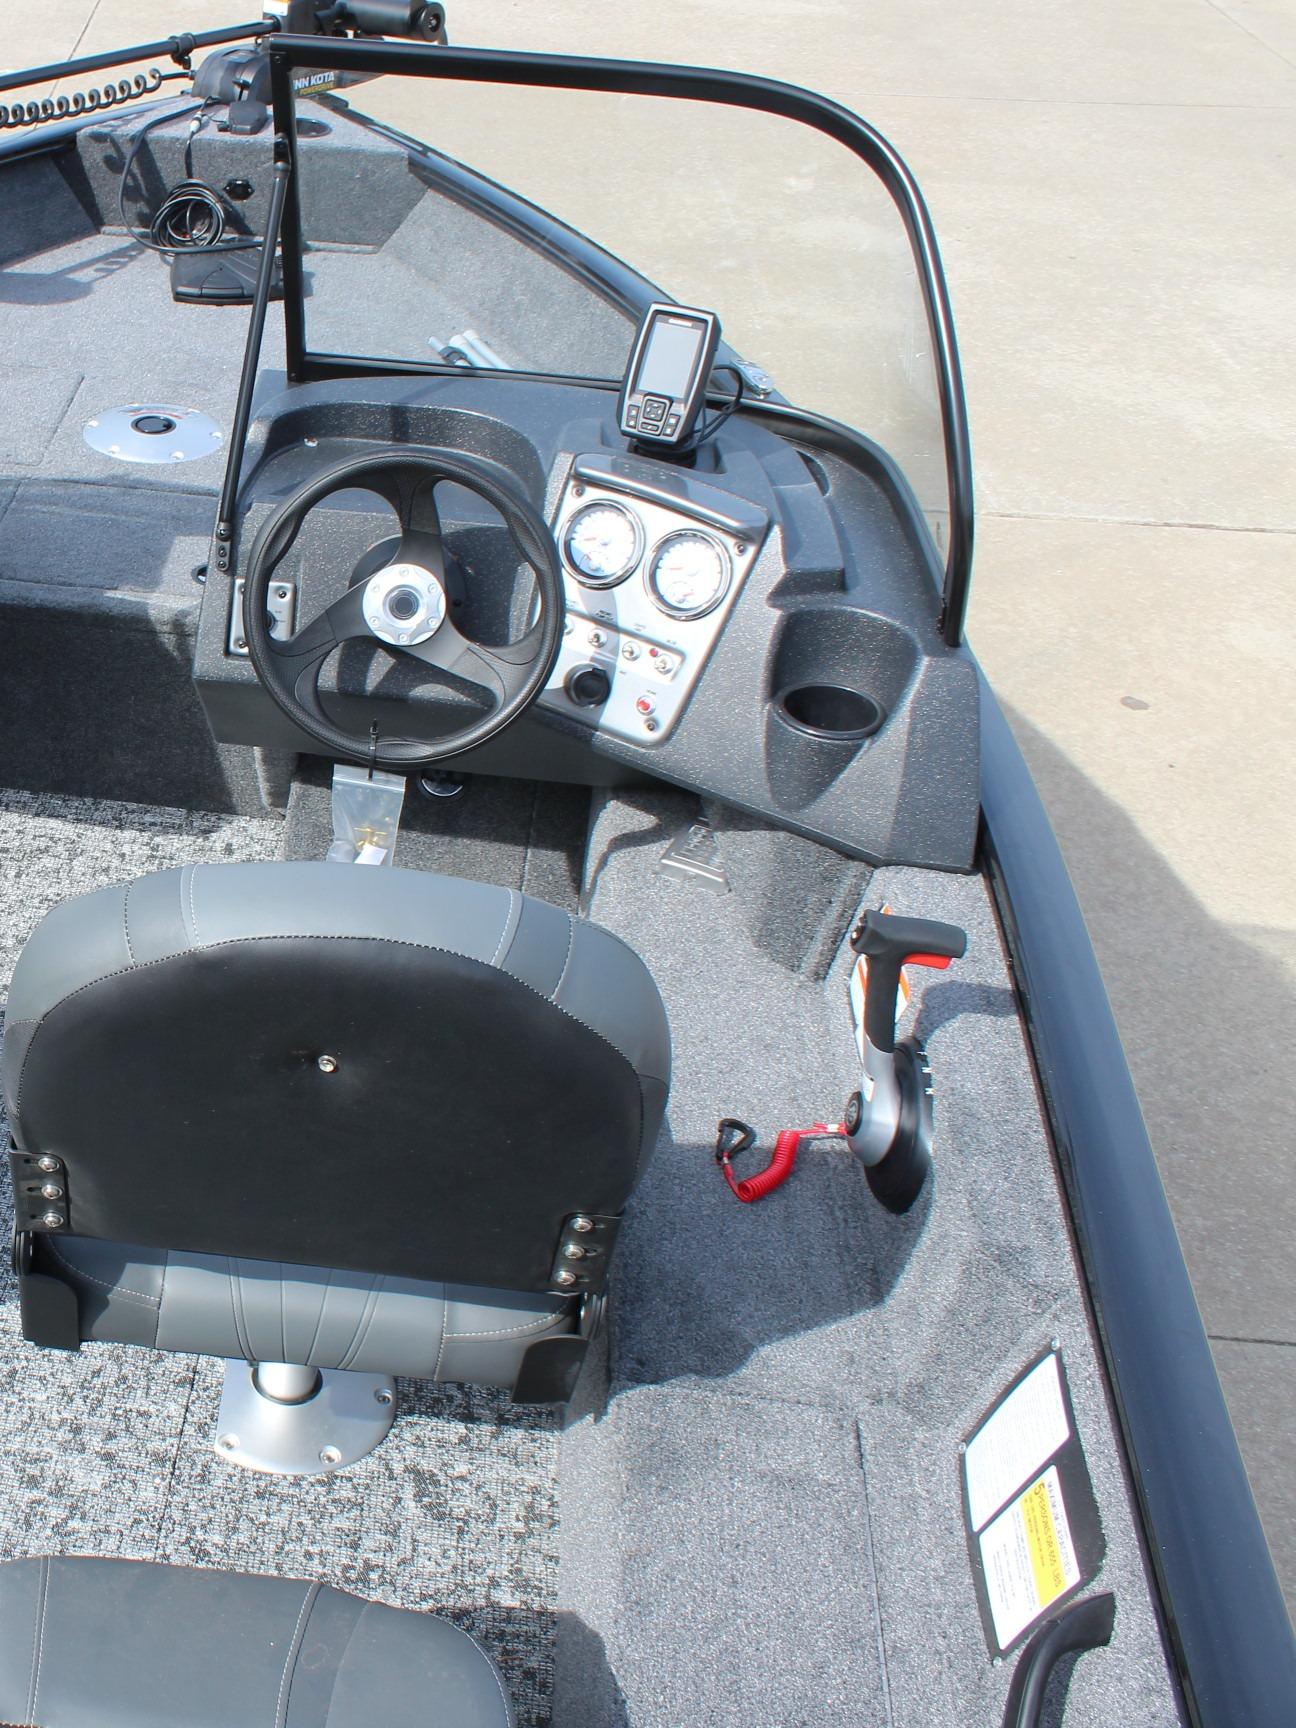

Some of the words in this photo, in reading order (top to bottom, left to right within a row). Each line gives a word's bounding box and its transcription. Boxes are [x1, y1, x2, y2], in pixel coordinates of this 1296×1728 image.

[292, 76, 309, 90] INN
[310, 72, 334, 85] KOTA
[1033, 1482, 1045, 1496] 5
